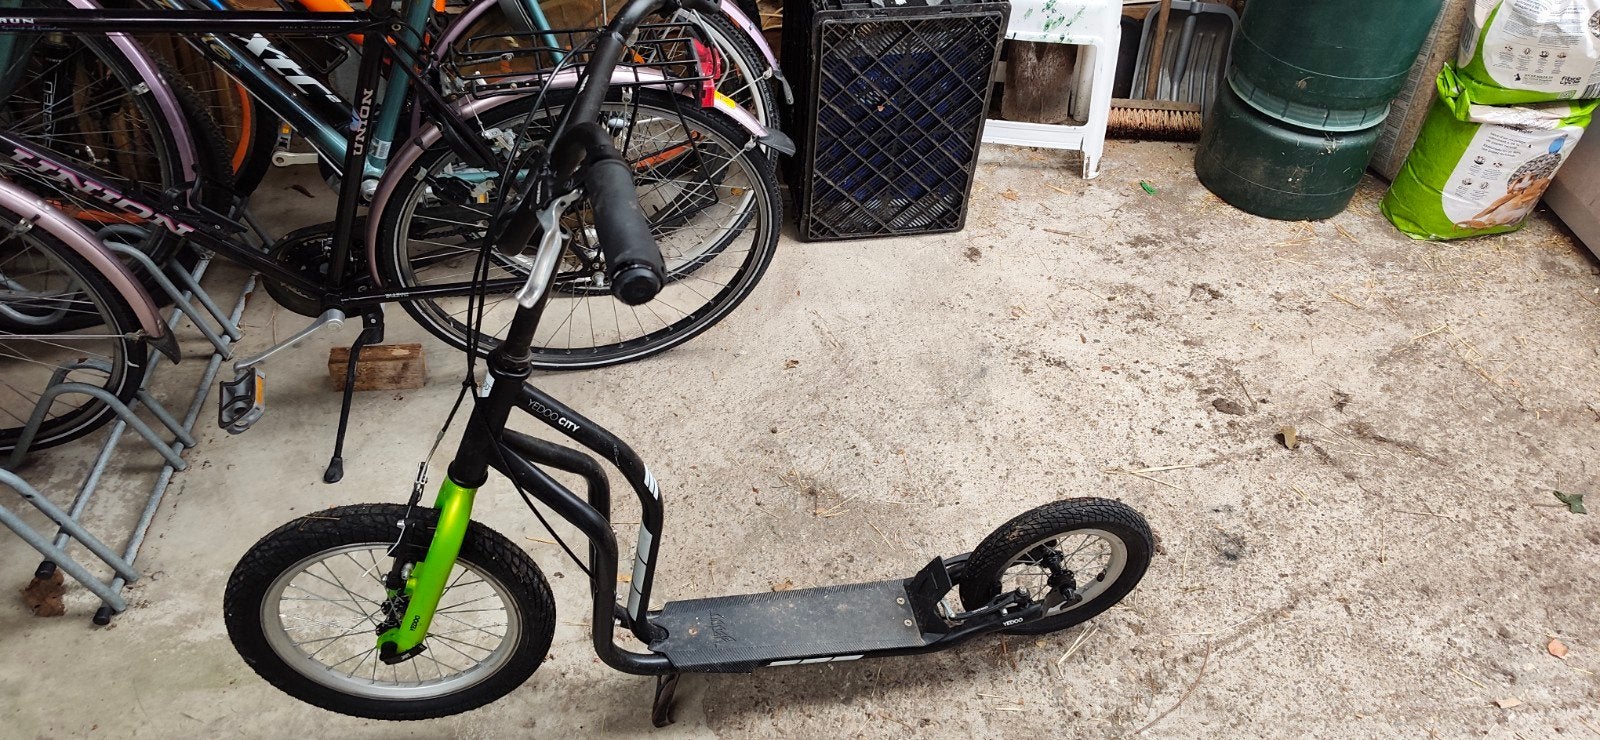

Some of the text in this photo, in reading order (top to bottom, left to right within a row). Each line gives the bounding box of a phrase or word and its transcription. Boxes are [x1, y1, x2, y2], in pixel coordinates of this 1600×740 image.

[352, 88, 374, 156] UNION
[10, 148, 196, 237] UNION
[528, 398, 580, 432] YEDOO CITY
[410, 614, 421, 632] YEDOO
[1002, 617, 1024, 627] YEDOO
